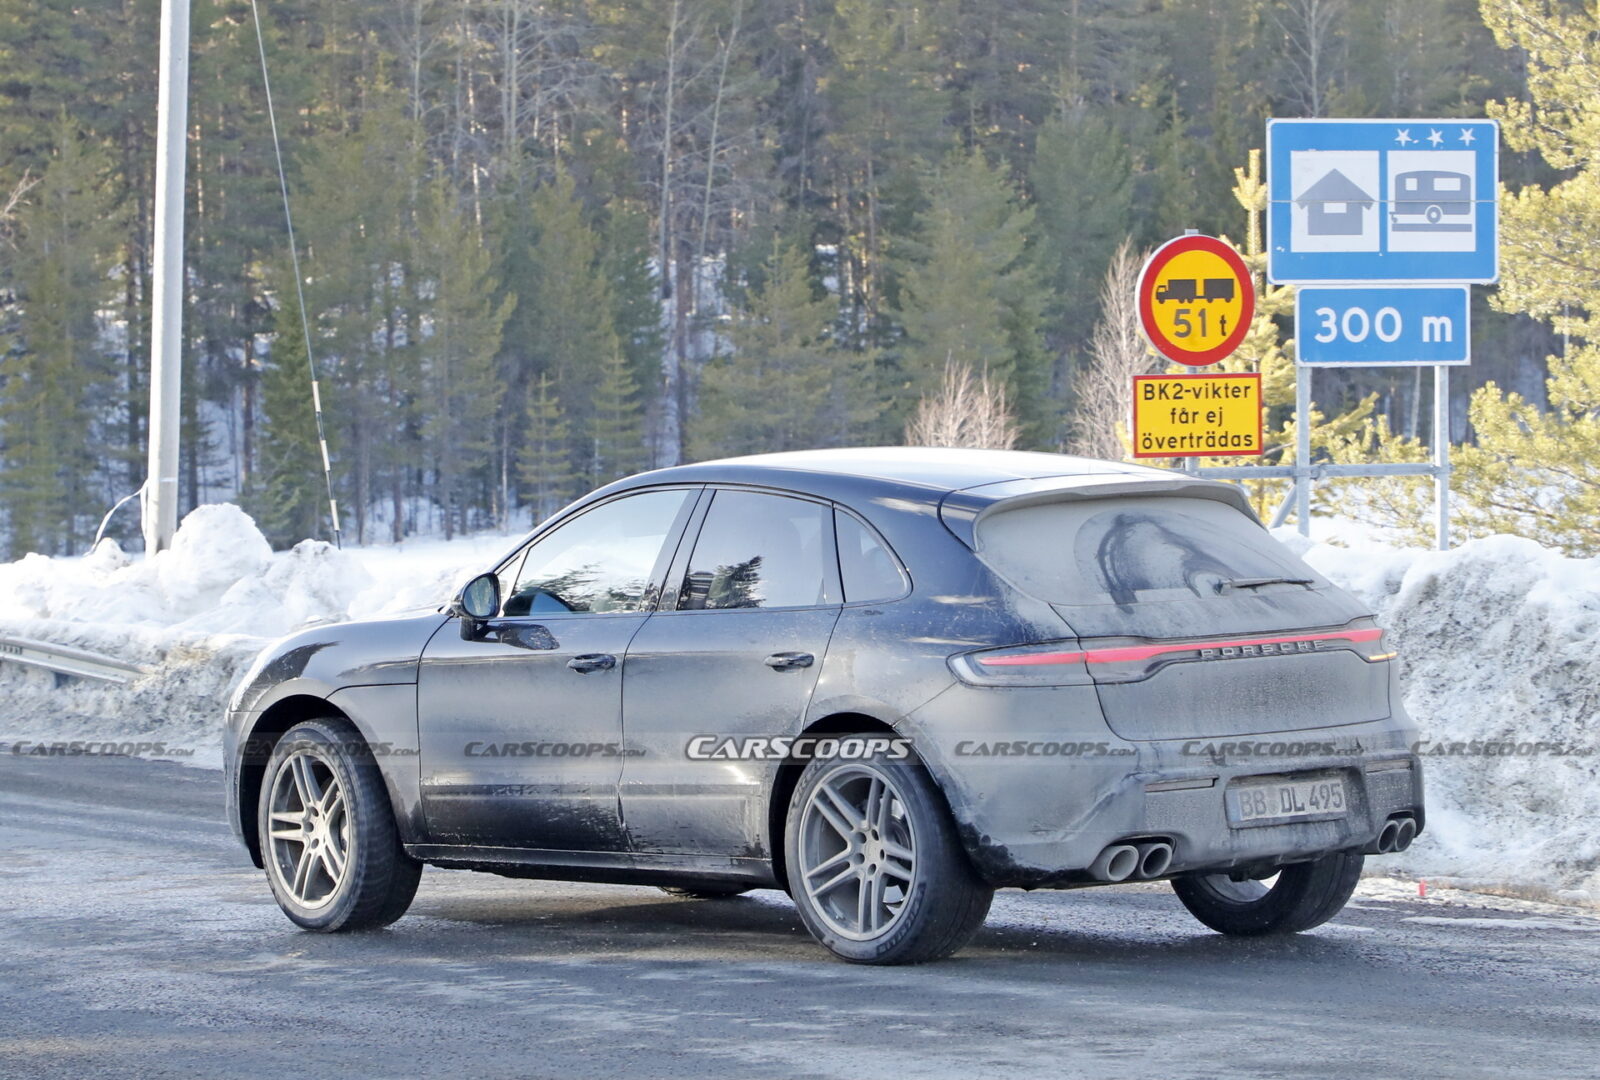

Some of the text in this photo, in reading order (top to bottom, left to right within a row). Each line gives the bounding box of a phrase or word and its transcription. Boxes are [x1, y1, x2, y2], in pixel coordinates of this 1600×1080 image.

[1174, 308, 1227, 338] 51 t
[1314, 306, 1452, 343] 300 m
[1143, 382, 1251, 401] BK2-vikter
[1170, 407, 1224, 427] får ej
[1142, 432, 1253, 450] överträdas
[1201, 640, 1325, 658] PORSCHE
[1239, 783, 1343, 818] BB DL 495
